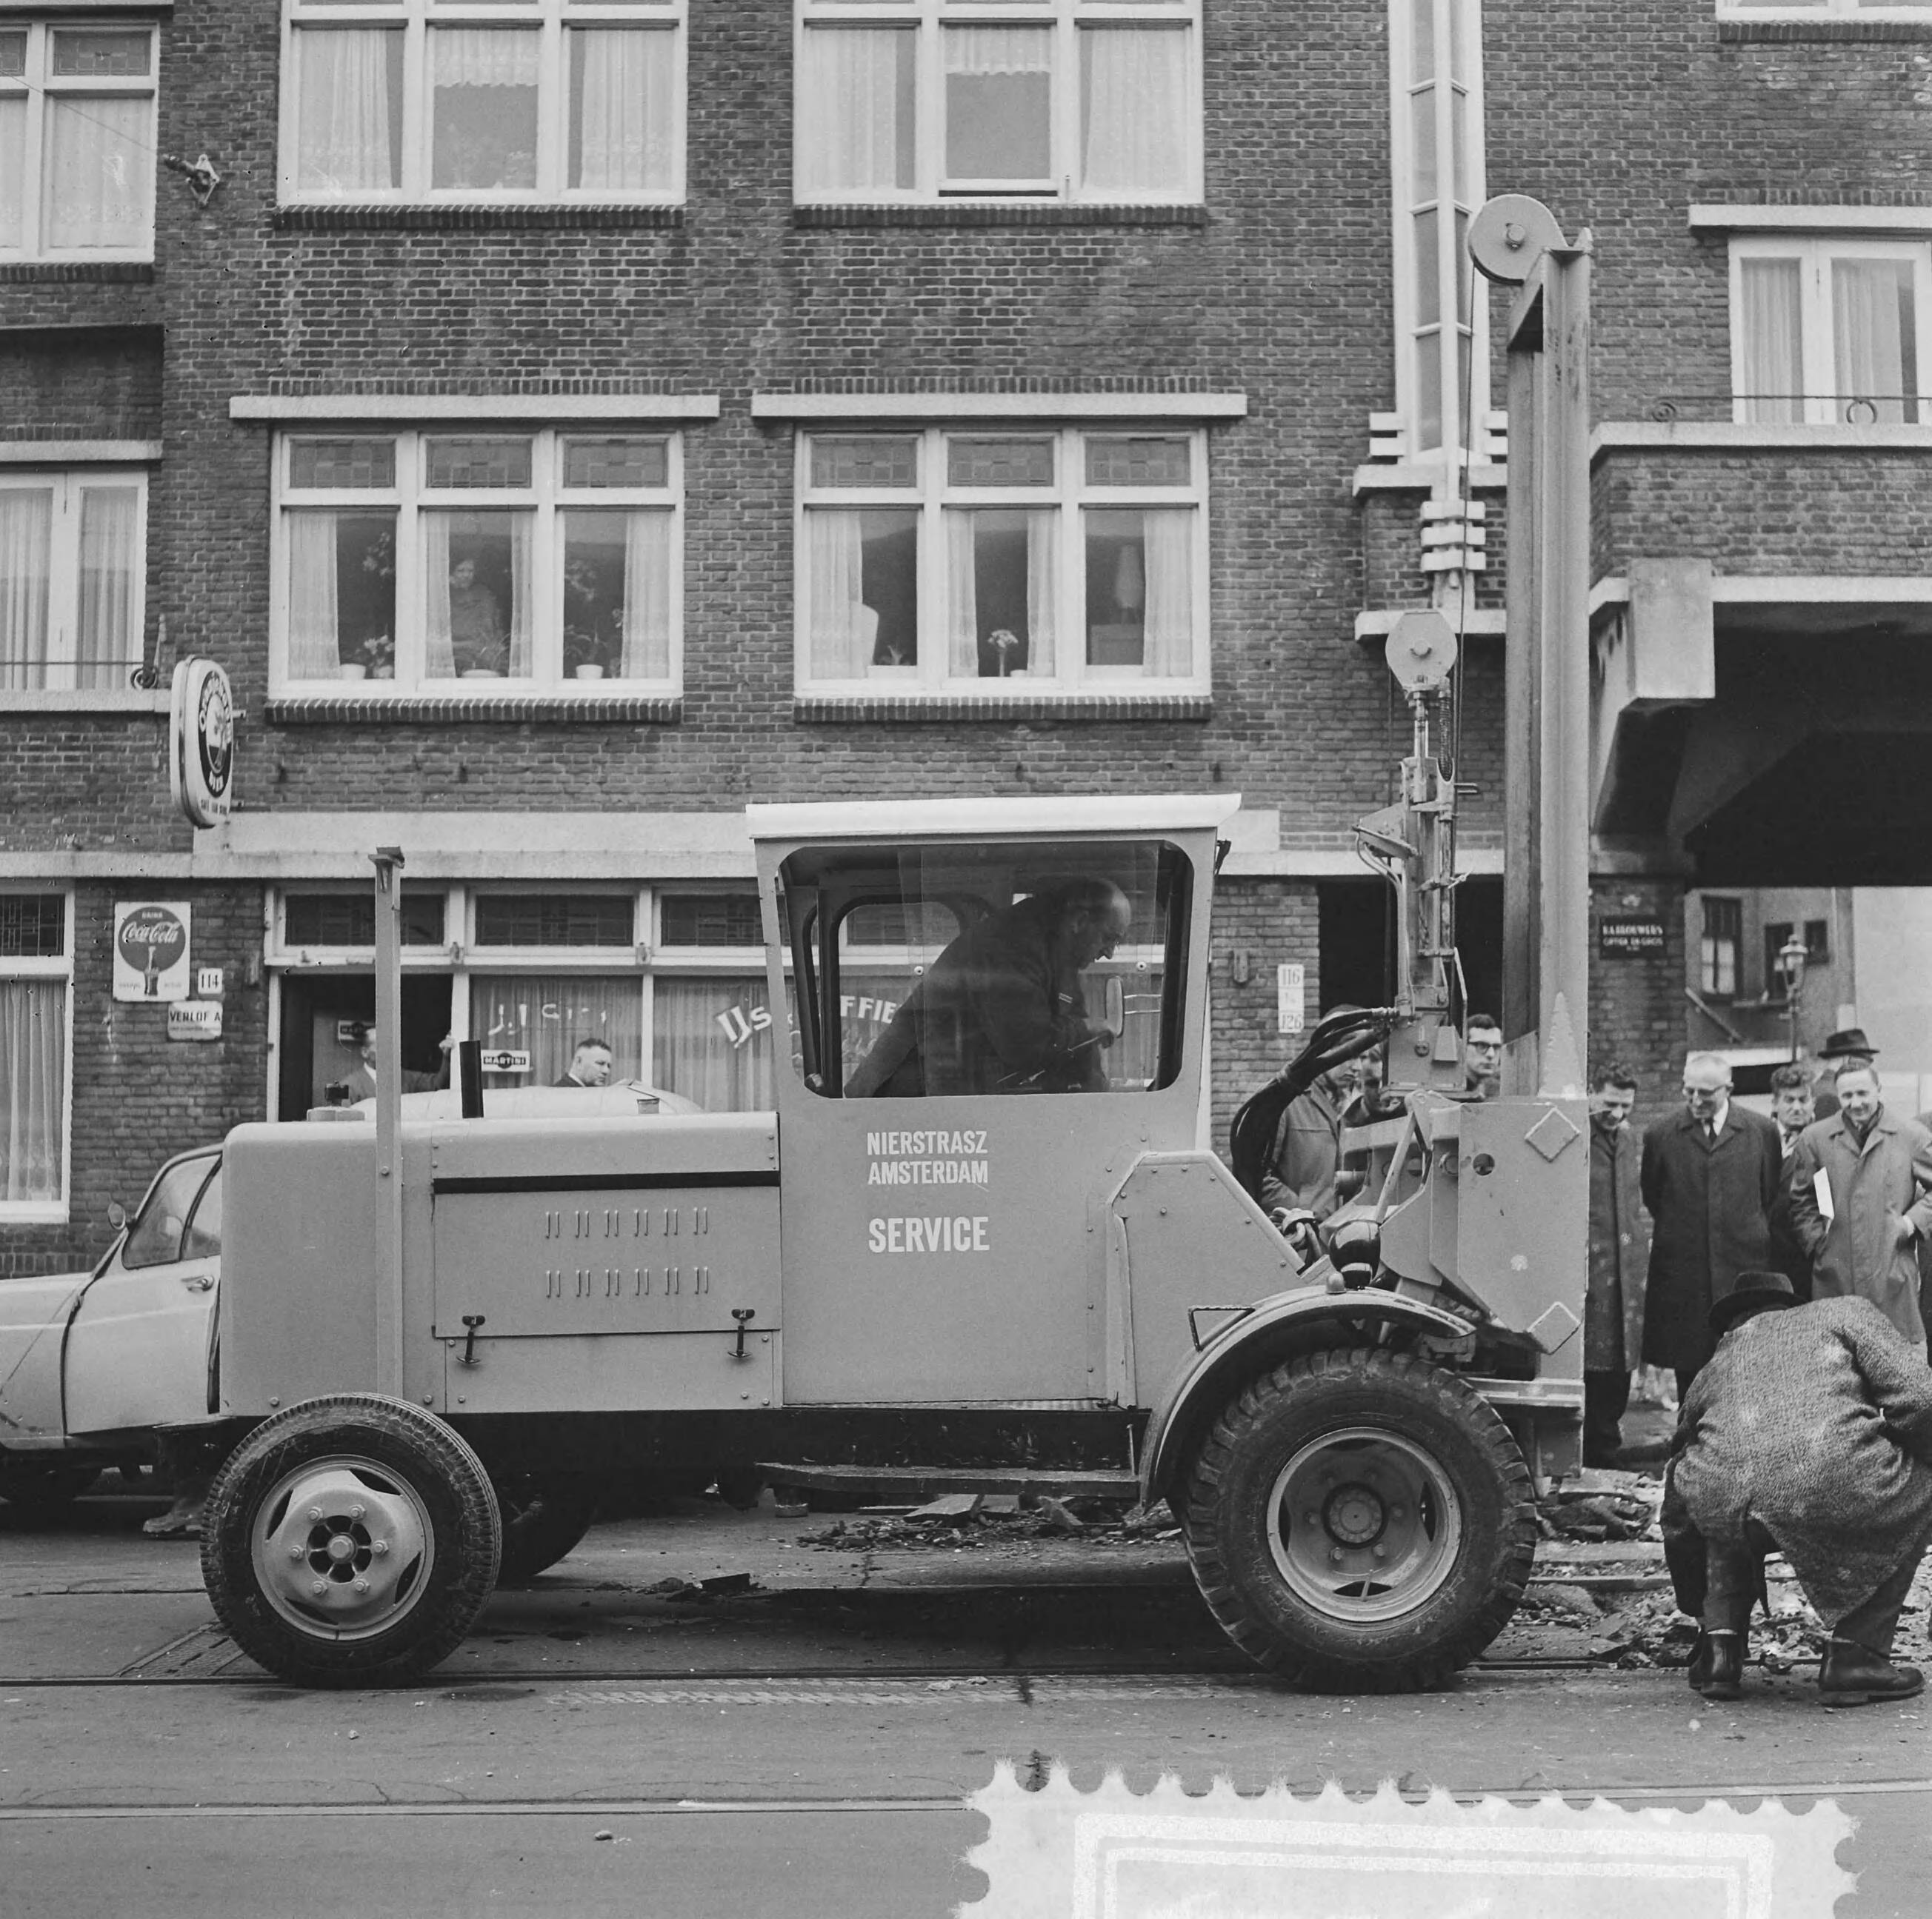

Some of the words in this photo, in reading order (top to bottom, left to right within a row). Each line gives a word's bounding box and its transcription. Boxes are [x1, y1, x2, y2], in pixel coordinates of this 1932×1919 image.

[201, 974, 219, 989] 114
[1282, 968, 1300, 985] 116
[213, 1010, 221, 1022] A
[840, 995, 898, 1025] FFIE
[1282, 1013, 1302, 1029] 126
[483, 1055, 527, 1066] MARTINI
[867, 1130, 988, 1155] NIERSTRASZ
[867, 1160, 988, 1185] AMSTERDAM
[868, 1216, 990, 1253] SERVICE
